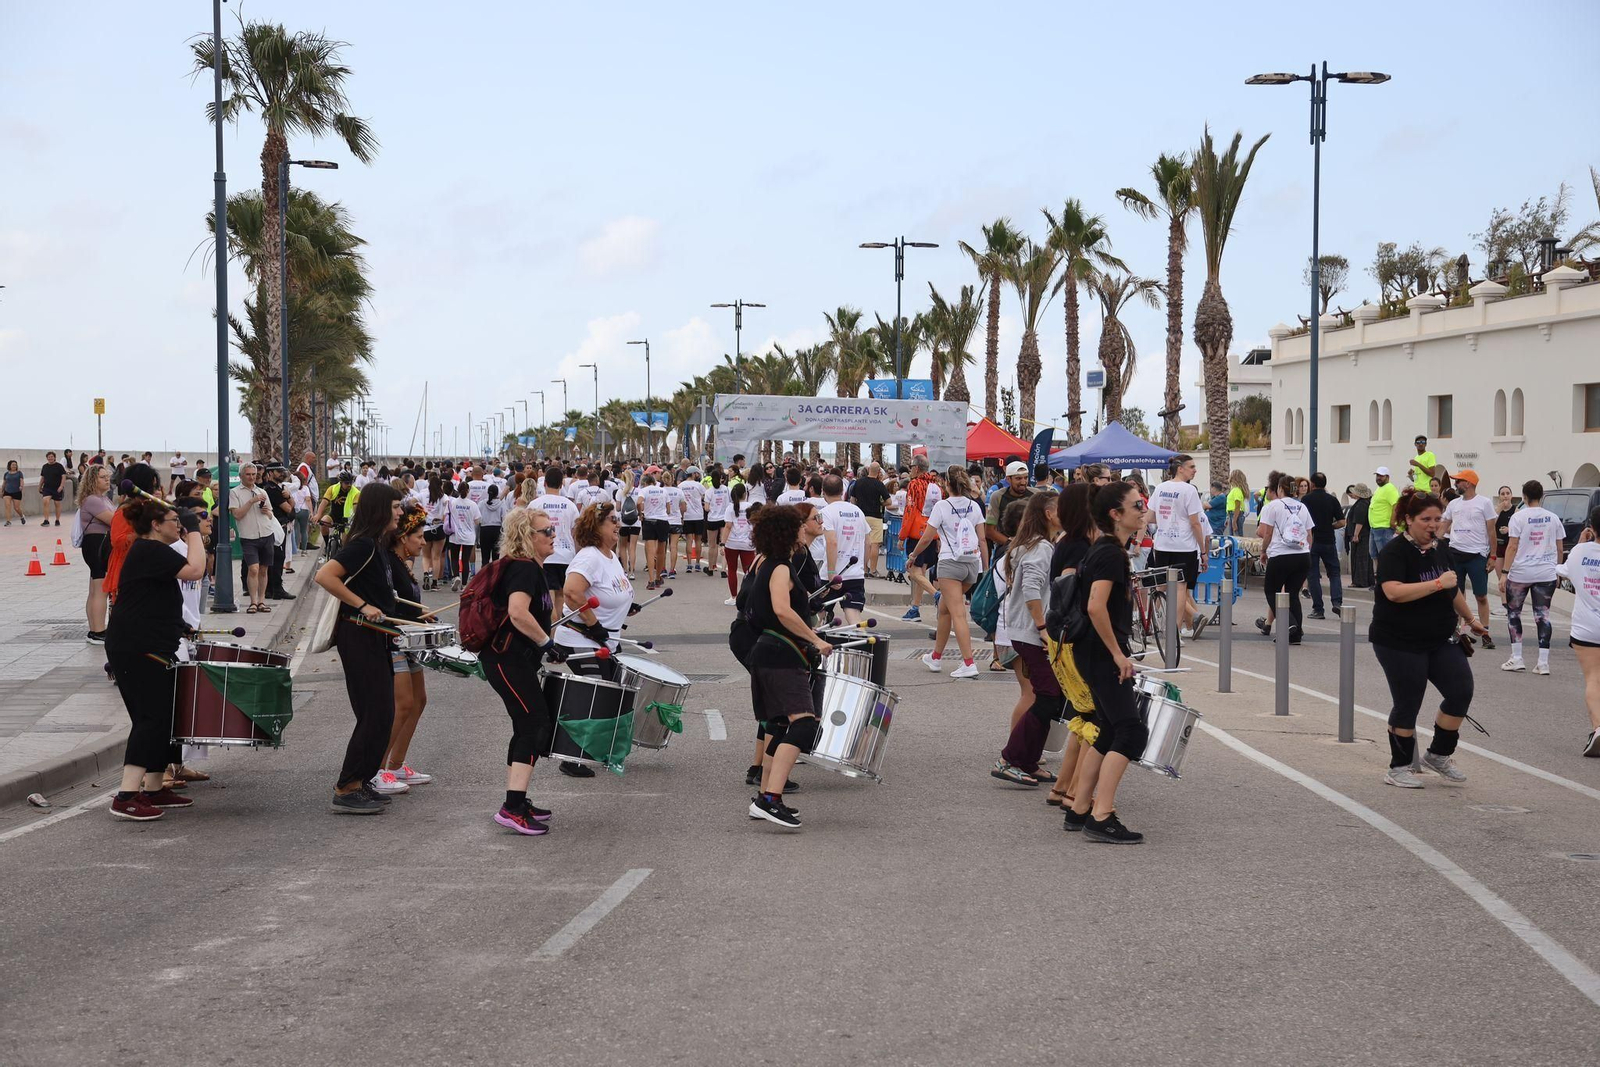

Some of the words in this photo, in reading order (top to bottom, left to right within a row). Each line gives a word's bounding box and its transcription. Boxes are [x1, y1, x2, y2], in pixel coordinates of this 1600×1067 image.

[798, 404, 812, 414] 3A
[816, 405, 870, 415] CARRERA
[874, 407, 888, 416] 5K
